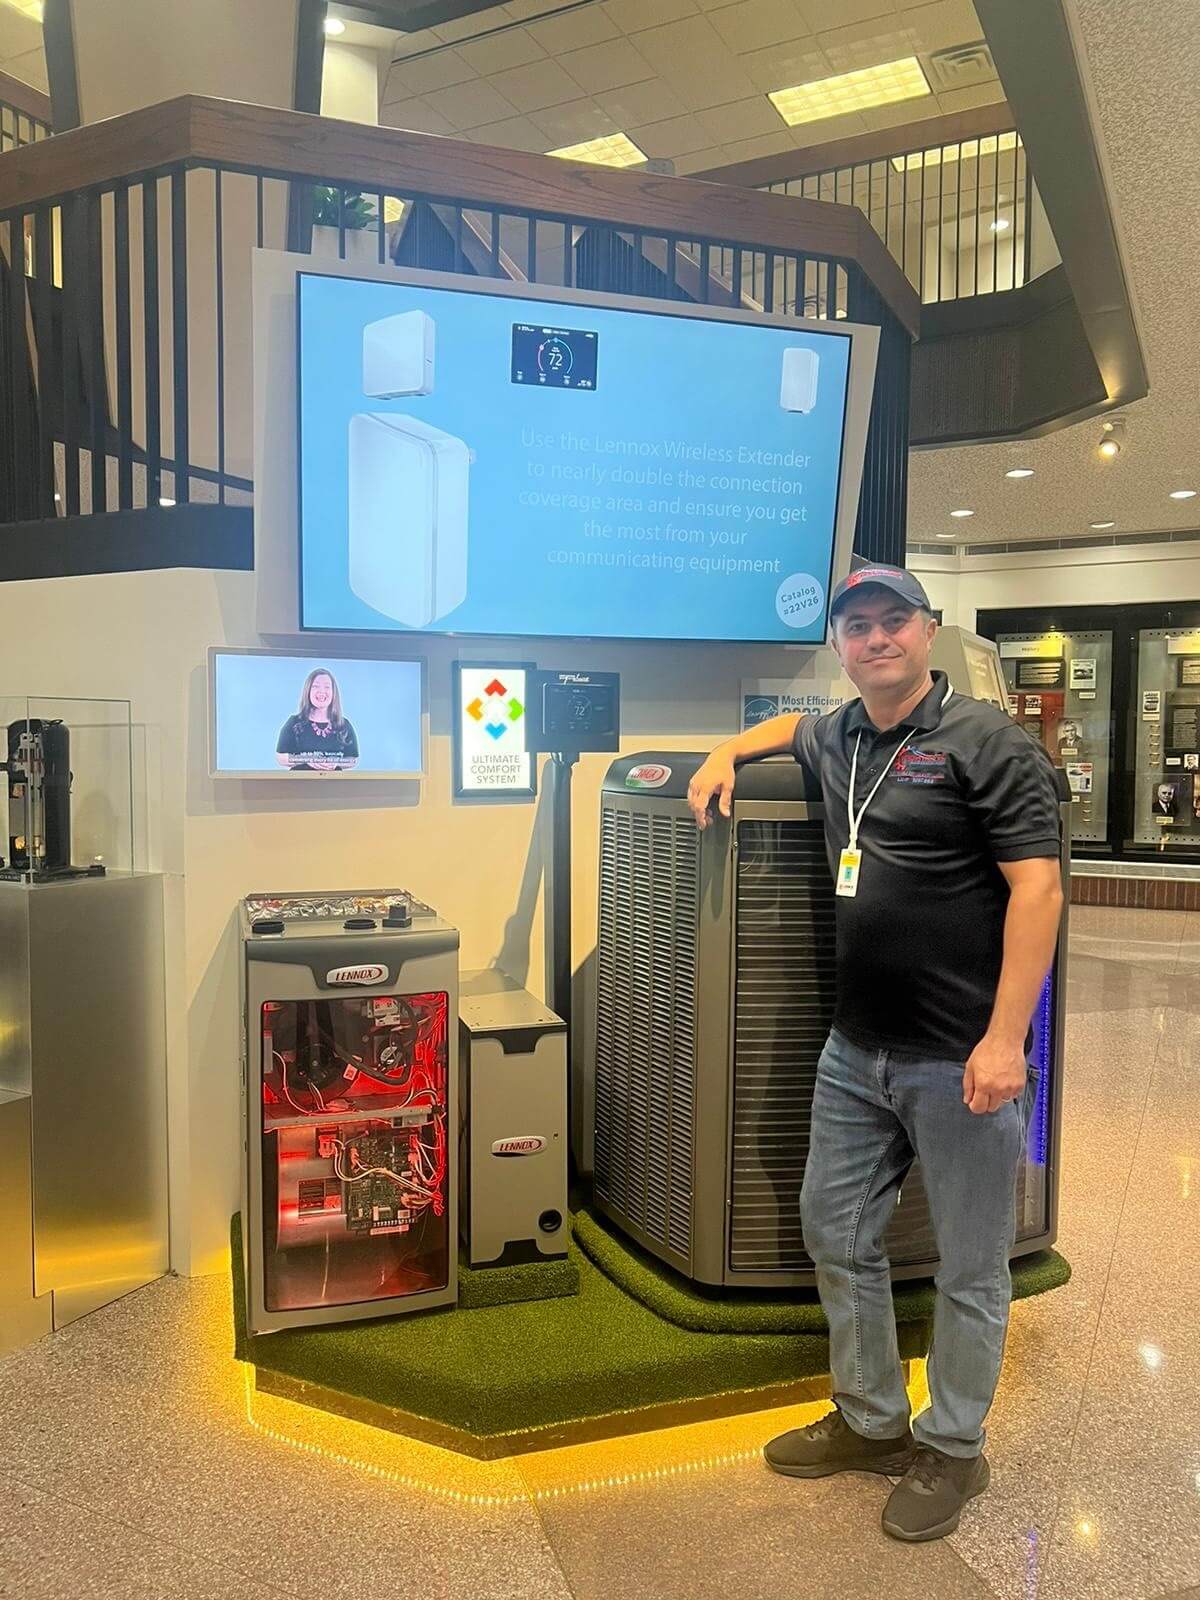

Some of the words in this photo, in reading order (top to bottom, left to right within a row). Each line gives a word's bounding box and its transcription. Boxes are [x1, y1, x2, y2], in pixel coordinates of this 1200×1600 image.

[548, 352, 563, 367] 72
[520, 424, 555, 448] Use
[560, 431, 591, 451] the
[595, 434, 660, 457] Lennox
[663, 440, 732, 463] Wireless
[738, 446, 812, 468] Extender
[527, 460, 545, 478] to
[551, 462, 607, 487] nearly
[610, 465, 673, 486] double
[678, 469, 706, 488] the
[710, 475, 803, 495] connection
[519, 490, 601, 512] coverage
[606, 496, 642, 513] area
[647, 497, 680, 514] and
[685, 503, 742, 518] ensure
[745, 504, 775, 523] you
[780, 507, 808, 525] get
[583, 520, 612, 538] the
[617, 525, 661, 540] most
[664, 524, 704, 543] from
[710, 530, 748, 546] your
[547, 550, 685, 570] communicating
[689, 556, 782, 575] equipment
[781, 586, 816, 603] Catalog
[783, 595, 819, 615] #22V26
[781, 695, 804, 706] Most
[806, 695, 843, 706] Efficient
[574, 705, 585, 716] 72
[471, 754, 520, 764] ULTIMATE
[471, 764, 521, 774] COMFORT
[476, 775, 516, 784] SYSTEM
[335, 969, 373, 981] LENNOX
[499, 1140, 534, 1151] LENNOX
